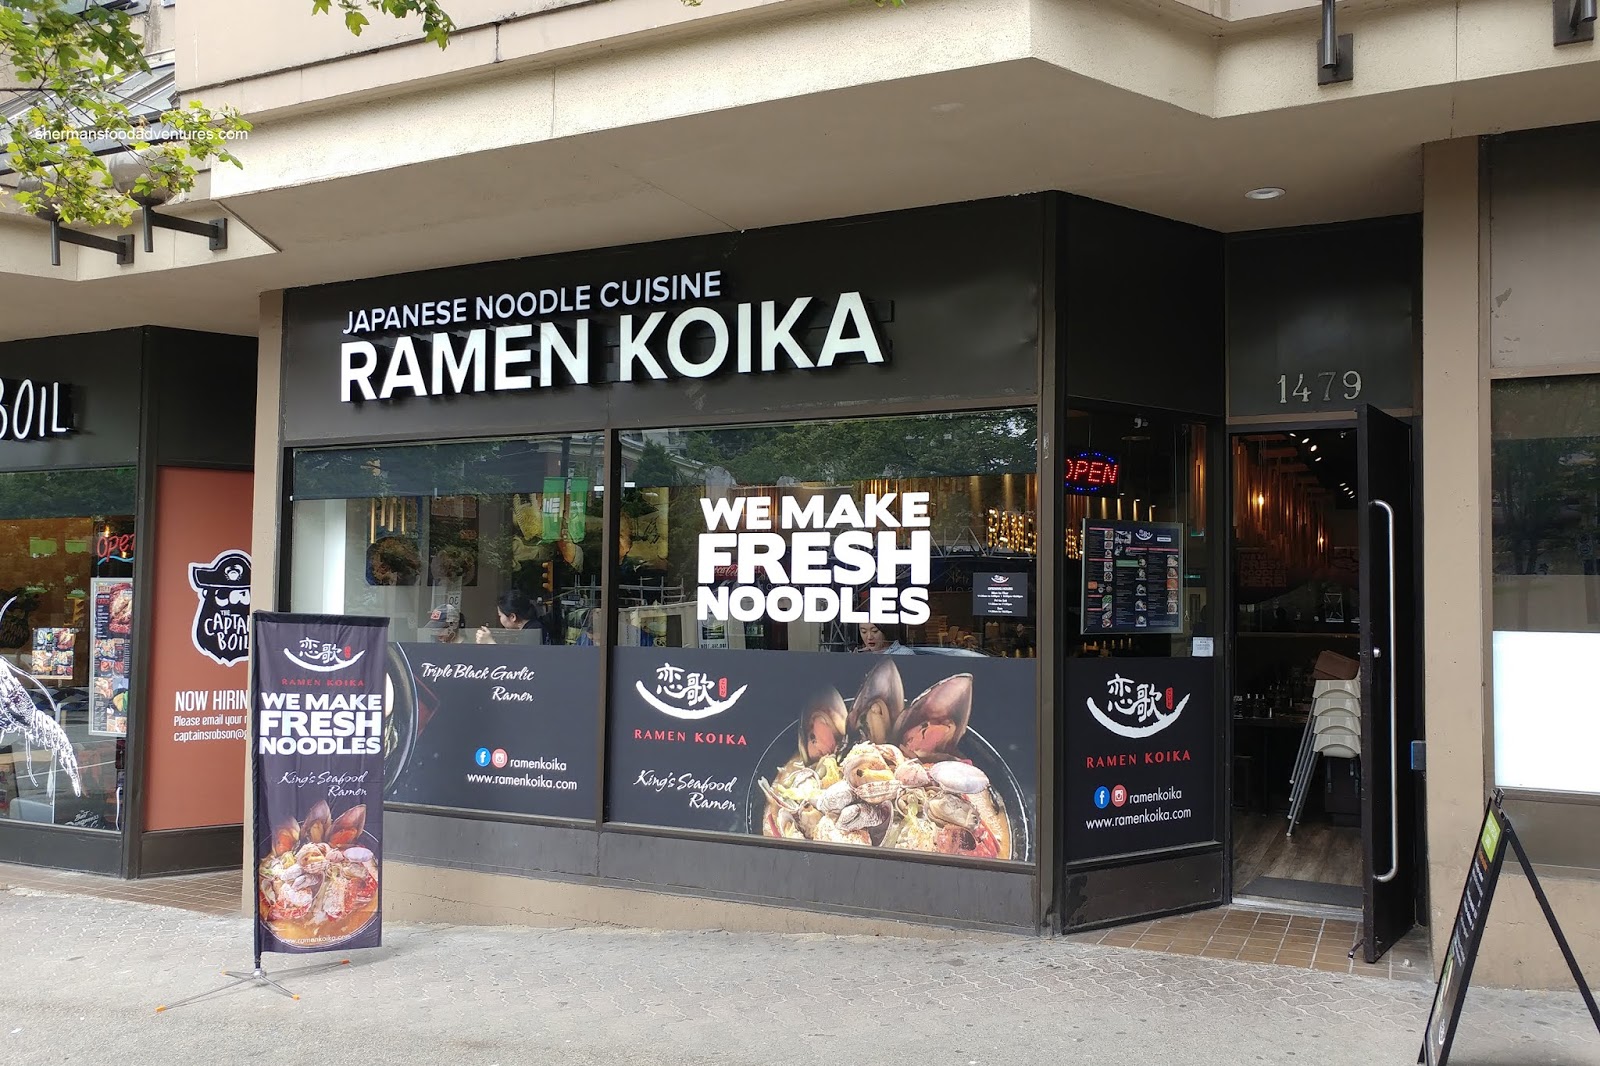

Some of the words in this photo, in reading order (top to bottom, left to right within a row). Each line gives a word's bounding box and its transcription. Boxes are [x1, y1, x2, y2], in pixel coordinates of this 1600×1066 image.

[343, 298, 467, 334] JAPANESE
[475, 286, 591, 319] NOODLE
[600, 270, 722, 307] CUISINE
[340, 319, 589, 402] RAMEN
[619, 292, 884, 381] KOIKA
[1277, 370, 1362, 404] 1479
[700, 496, 772, 531] WE
[781, 492, 931, 529] MAKE
[698, 530, 931, 585] FRESH
[697, 586, 931, 625] NOODLES
[204, 612, 250, 636] CAPTAI
[217, 631, 250, 650] BOIL
[421, 662, 453, 682] Triple
[453, 663, 490, 680] Black
[490, 665, 535, 681] Garlic
[281, 678, 321, 686] RAMEN
[326, 679, 365, 687] KOIKA
[175, 690, 208, 711] NOW
[213, 690, 248, 711] HIRIN
[261, 692, 300, 710] WE
[305, 693, 382, 711] MAKE
[491, 686, 534, 702] Ramen
[174, 715, 200, 727] Please
[202, 714, 223, 726] email
[225, 715, 242, 726] your
[260, 710, 382, 737] FRESH
[259, 737, 381, 755] NOODLES
[634, 729, 686, 742] RAMEN
[695, 733, 747, 746] KOIKA
[510, 757, 567, 771] ramenkoika
[1086, 754, 1138, 769] RAMEN
[1144, 750, 1191, 764] KOIKA
[277, 771, 315, 788] King's
[316, 770, 369, 786] Seafood
[467, 773, 578, 791] www.ramenkoika.com
[633, 769, 676, 793] King's
[676, 773, 738, 794] Seafood
[327, 785, 368, 797] Ramen
[1129, 785, 1182, 804] ramenkoika
[688, 792, 737, 811] Ramen
[1086, 807, 1192, 830] www.ramenkoika.com
